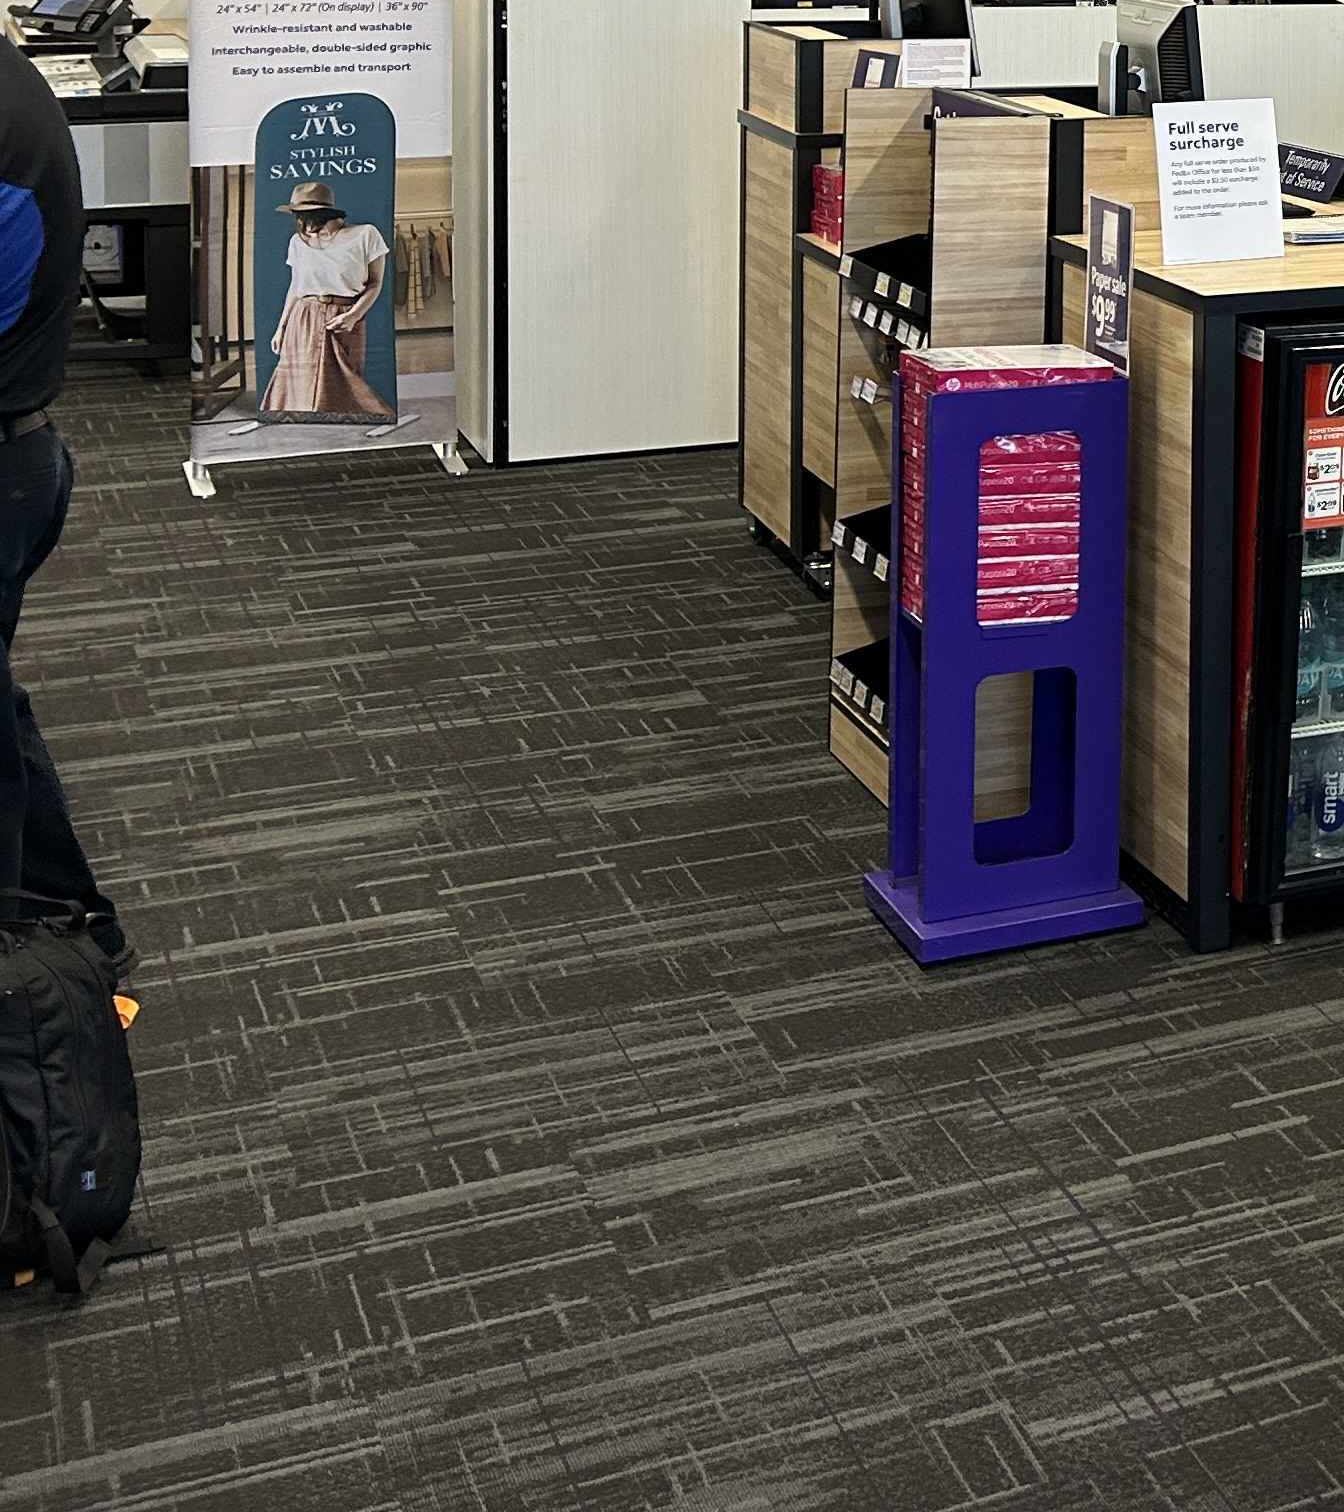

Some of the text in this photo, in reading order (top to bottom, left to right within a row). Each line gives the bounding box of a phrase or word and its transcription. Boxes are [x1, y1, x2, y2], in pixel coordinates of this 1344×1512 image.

[337, 1, 375, 13] display)
[232, 22, 412, 34] Wrinkle-resistant and washable
[211, 42, 432, 56] Interchangeable, double-sided graphic
[232, 62, 411, 76] Easy to assemble and transport
[1167, 119, 1240, 136] Full serve
[1169, 135, 1245, 151] surcharge
[289, 145, 357, 160] STYLISH
[270, 157, 377, 180] SAVINGS
[1285, 149, 1331, 175] Temporarily
[1286, 171, 1326, 193] of Service
[1091, 266, 1127, 297] Paper sale
[1322, 771, 1339, 825] smart
